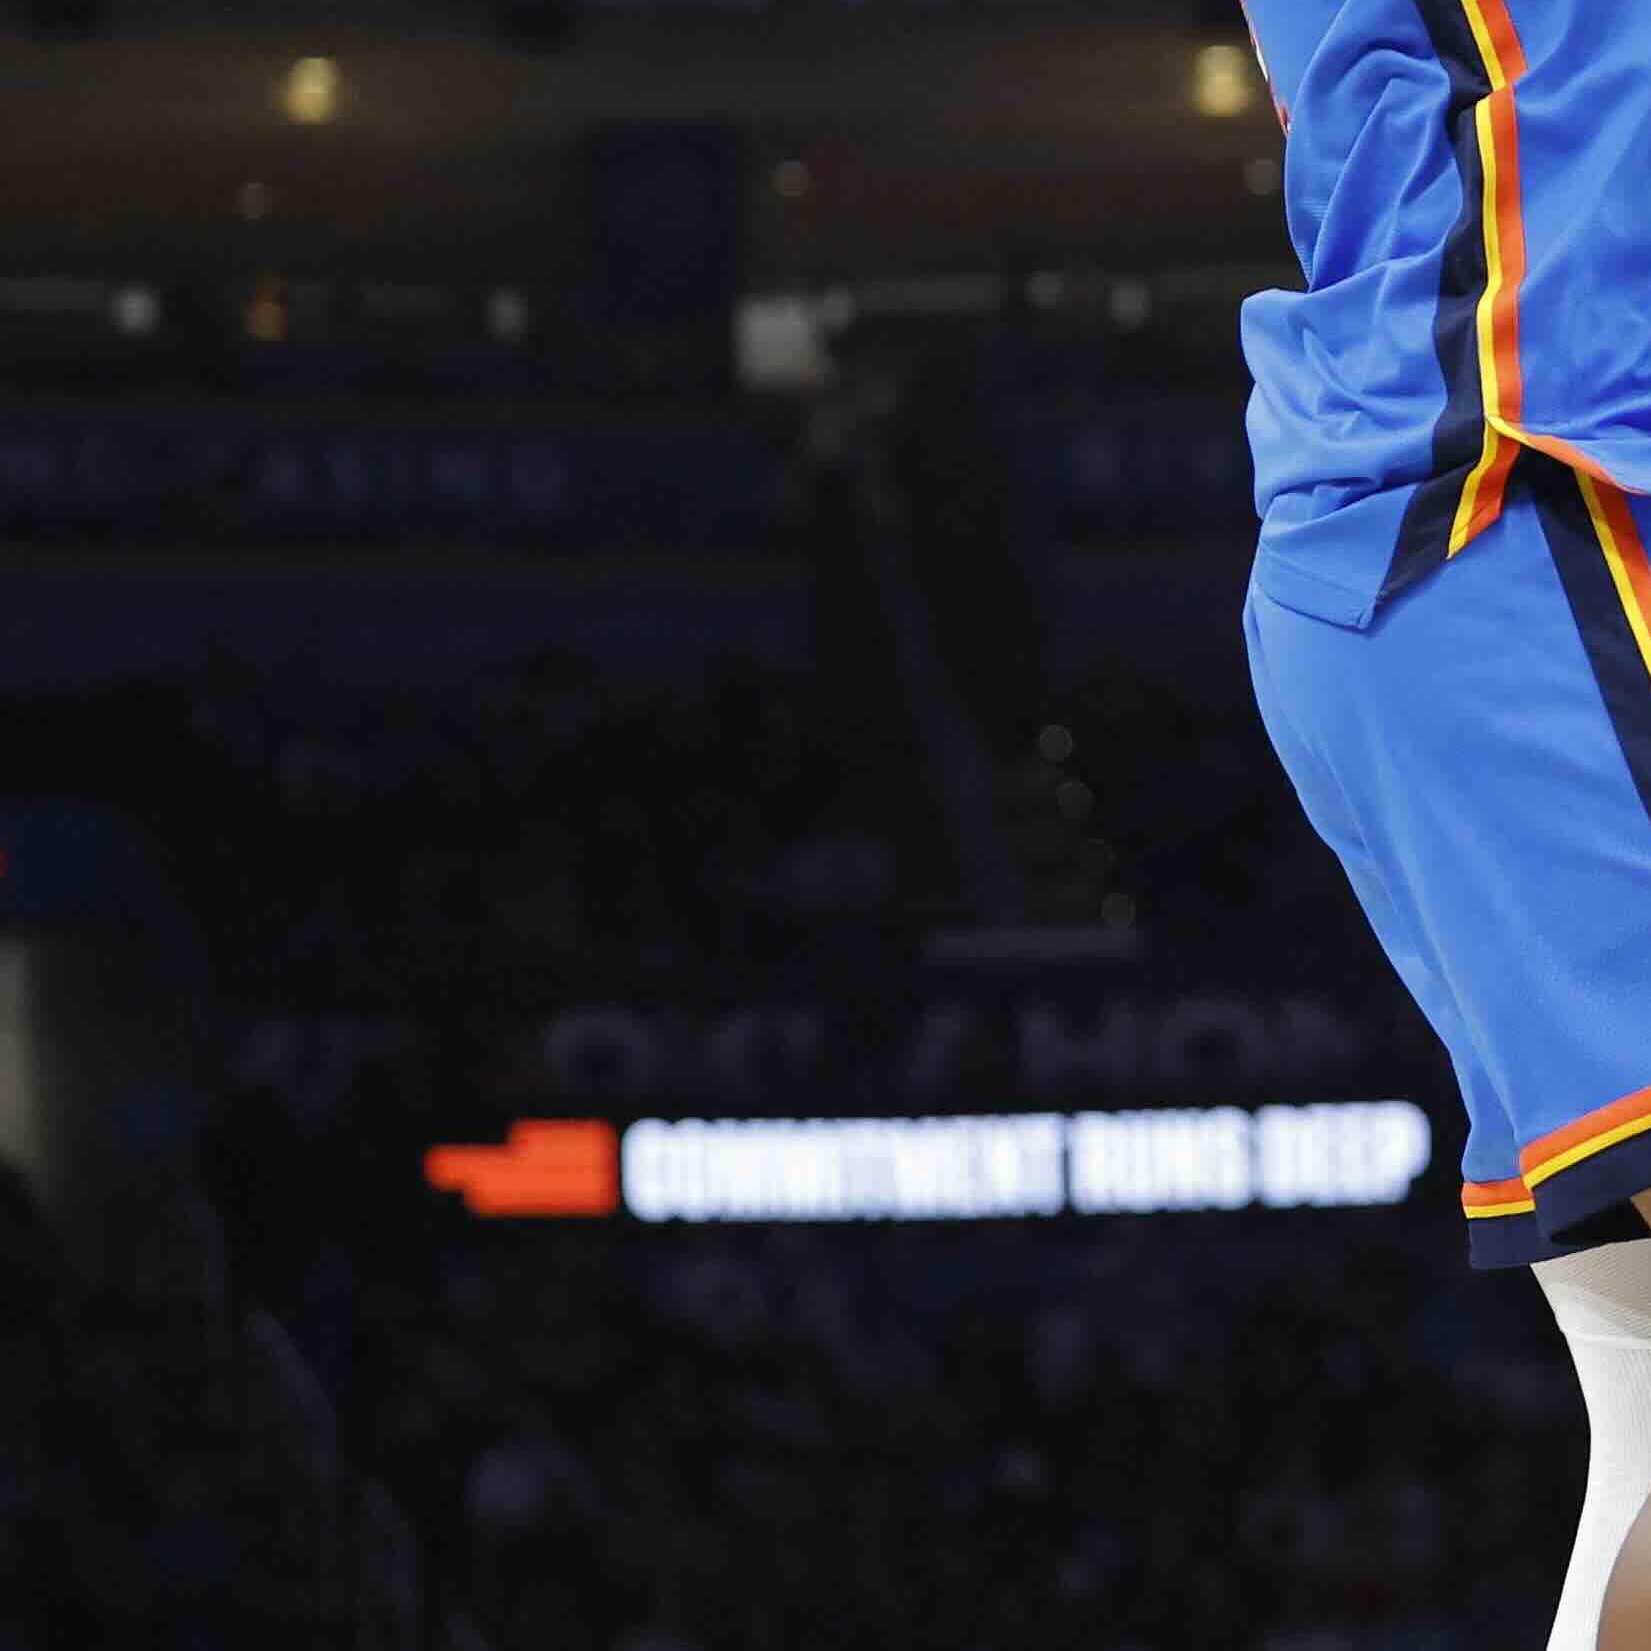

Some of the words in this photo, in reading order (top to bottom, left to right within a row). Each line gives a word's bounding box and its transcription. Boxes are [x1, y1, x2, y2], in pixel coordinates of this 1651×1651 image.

[622, 1113, 1065, 1221] COMMITMENT
[1068, 1107, 1256, 1212] RUNS
[1257, 1100, 1430, 1207] DEEP
